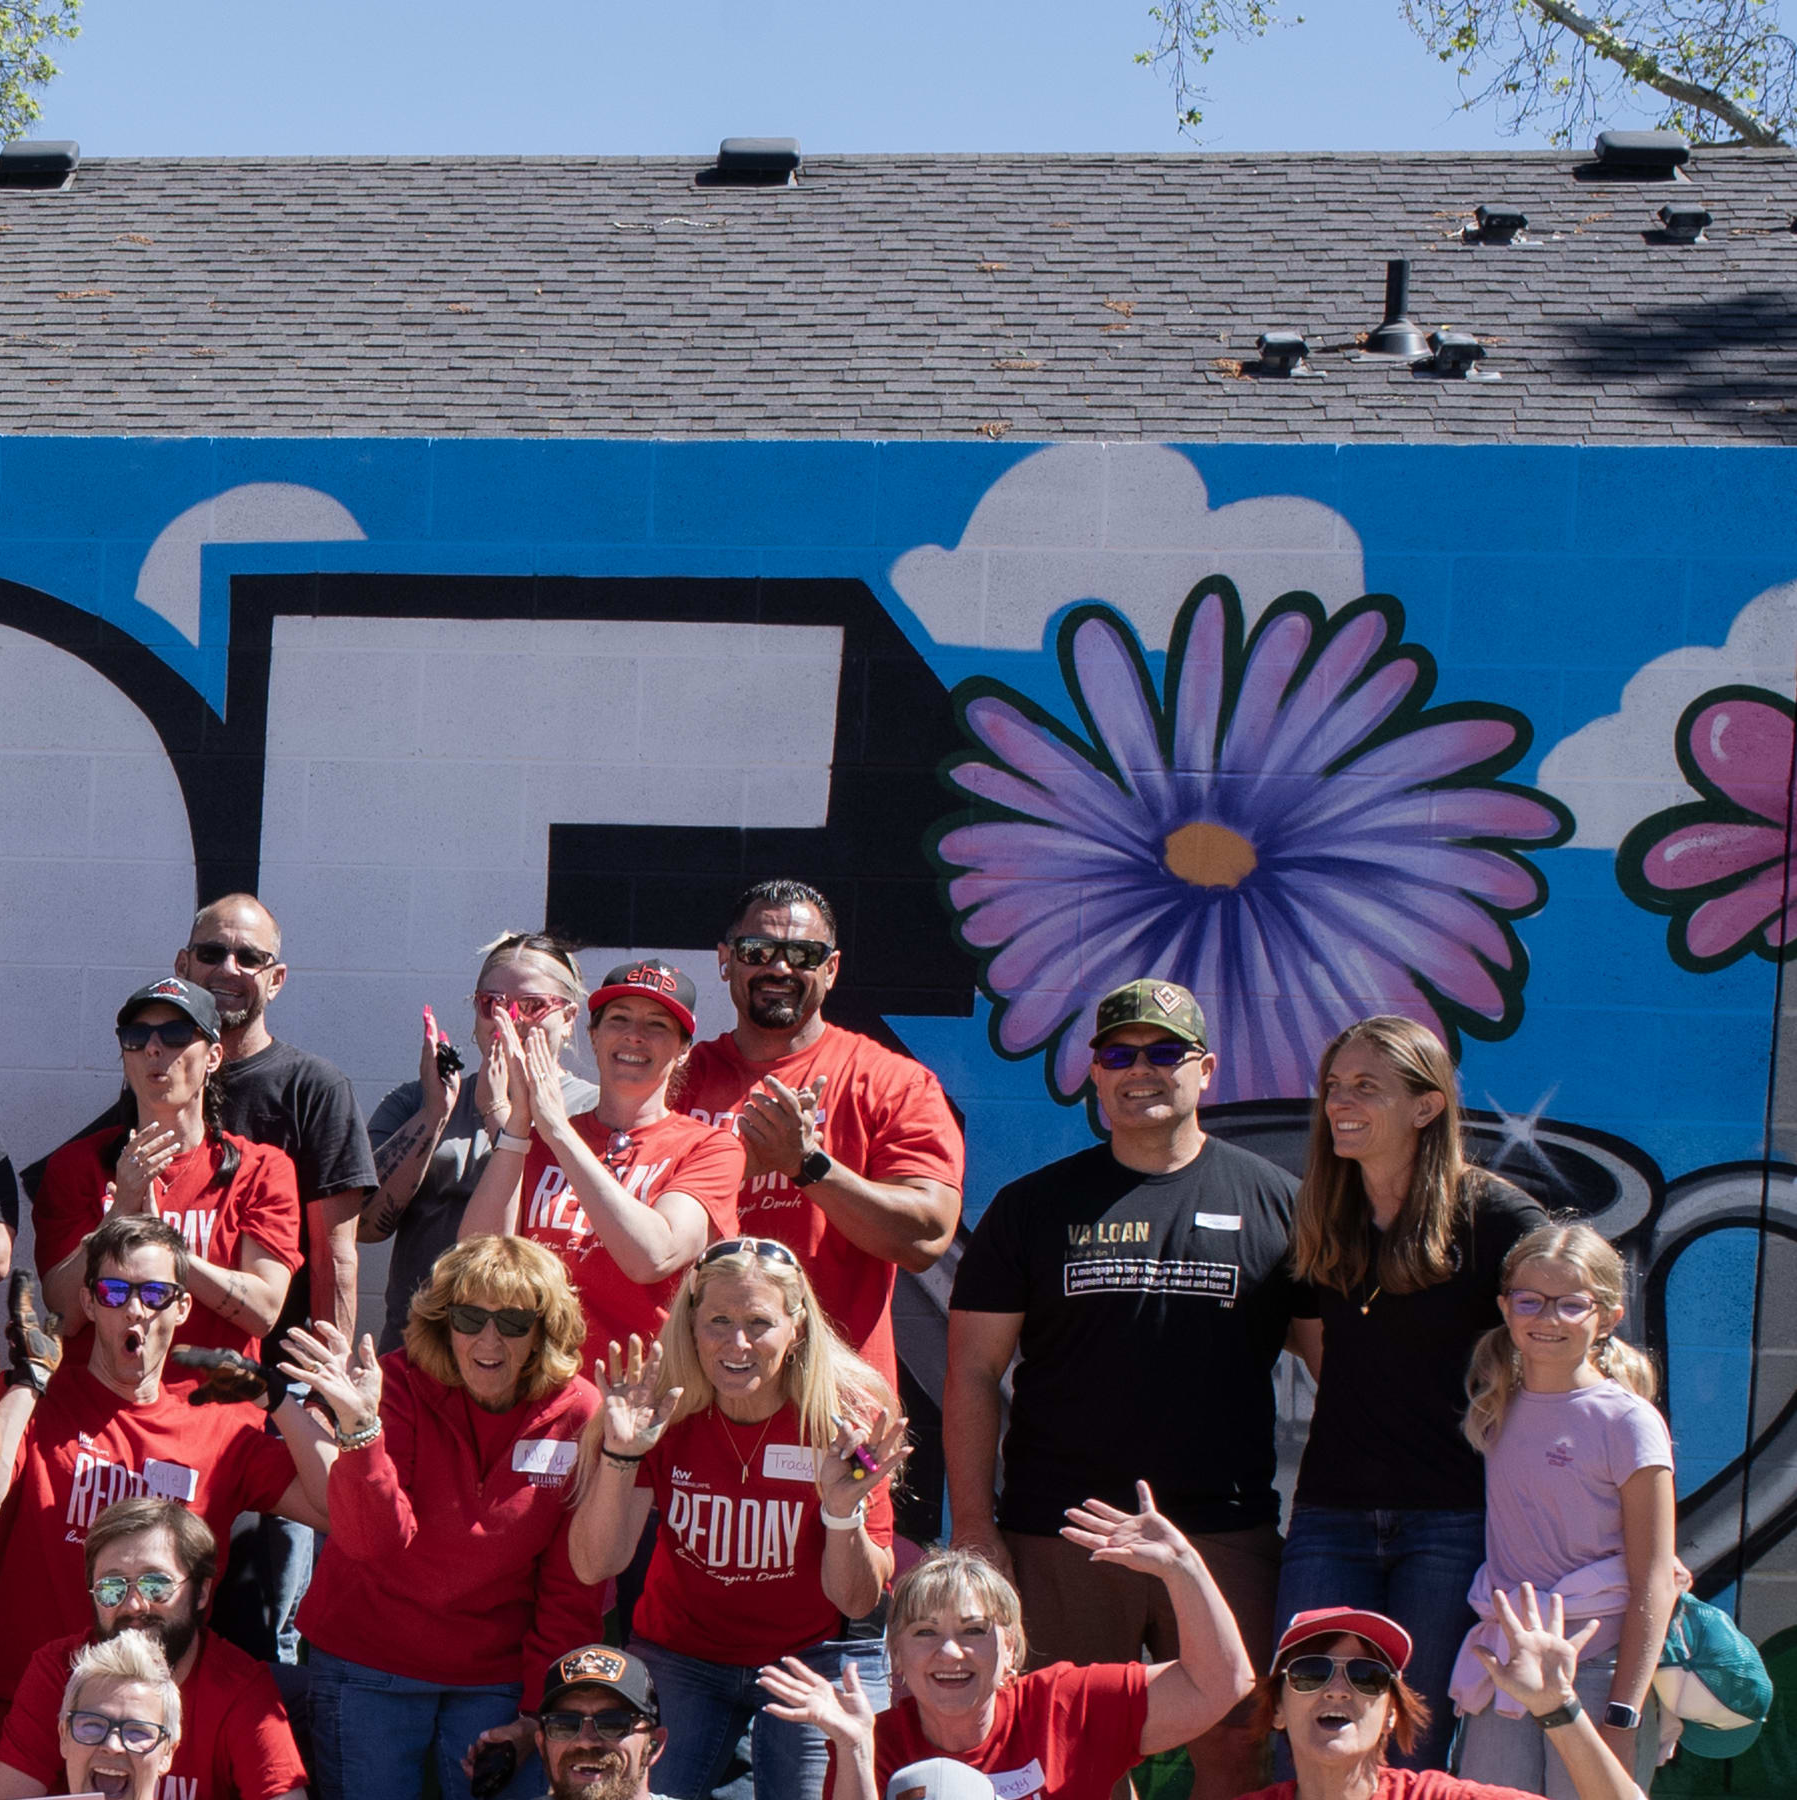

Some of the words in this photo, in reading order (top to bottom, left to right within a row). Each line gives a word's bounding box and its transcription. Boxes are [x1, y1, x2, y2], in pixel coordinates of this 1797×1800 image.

[1067, 1224, 1093, 1246] VA
[1097, 1221, 1150, 1243] LOAN
[1078, 1264, 1114, 1277] mortgage
[1115, 1263, 1123, 1273] to
[1124, 1264, 1138, 1275] buy
[1172, 1265, 1193, 1277] which
[1195, 1266, 1207, 1277] the
[1209, 1267, 1232, 1279] down
[1071, 1277, 1104, 1290] payment
[1105, 1277, 1119, 1286] was
[1121, 1276, 1137, 1287] paid
[1193, 1279, 1208, 1288] and
[1209, 1280, 1230, 1291] tears
[524, 1450, 571, 1473] Mary
[672, 1465, 693, 1480] kw
[768, 1450, 814, 1479] Tracy
[668, 1488, 733, 1567] RED
[737, 1498, 804, 1569] DAY
